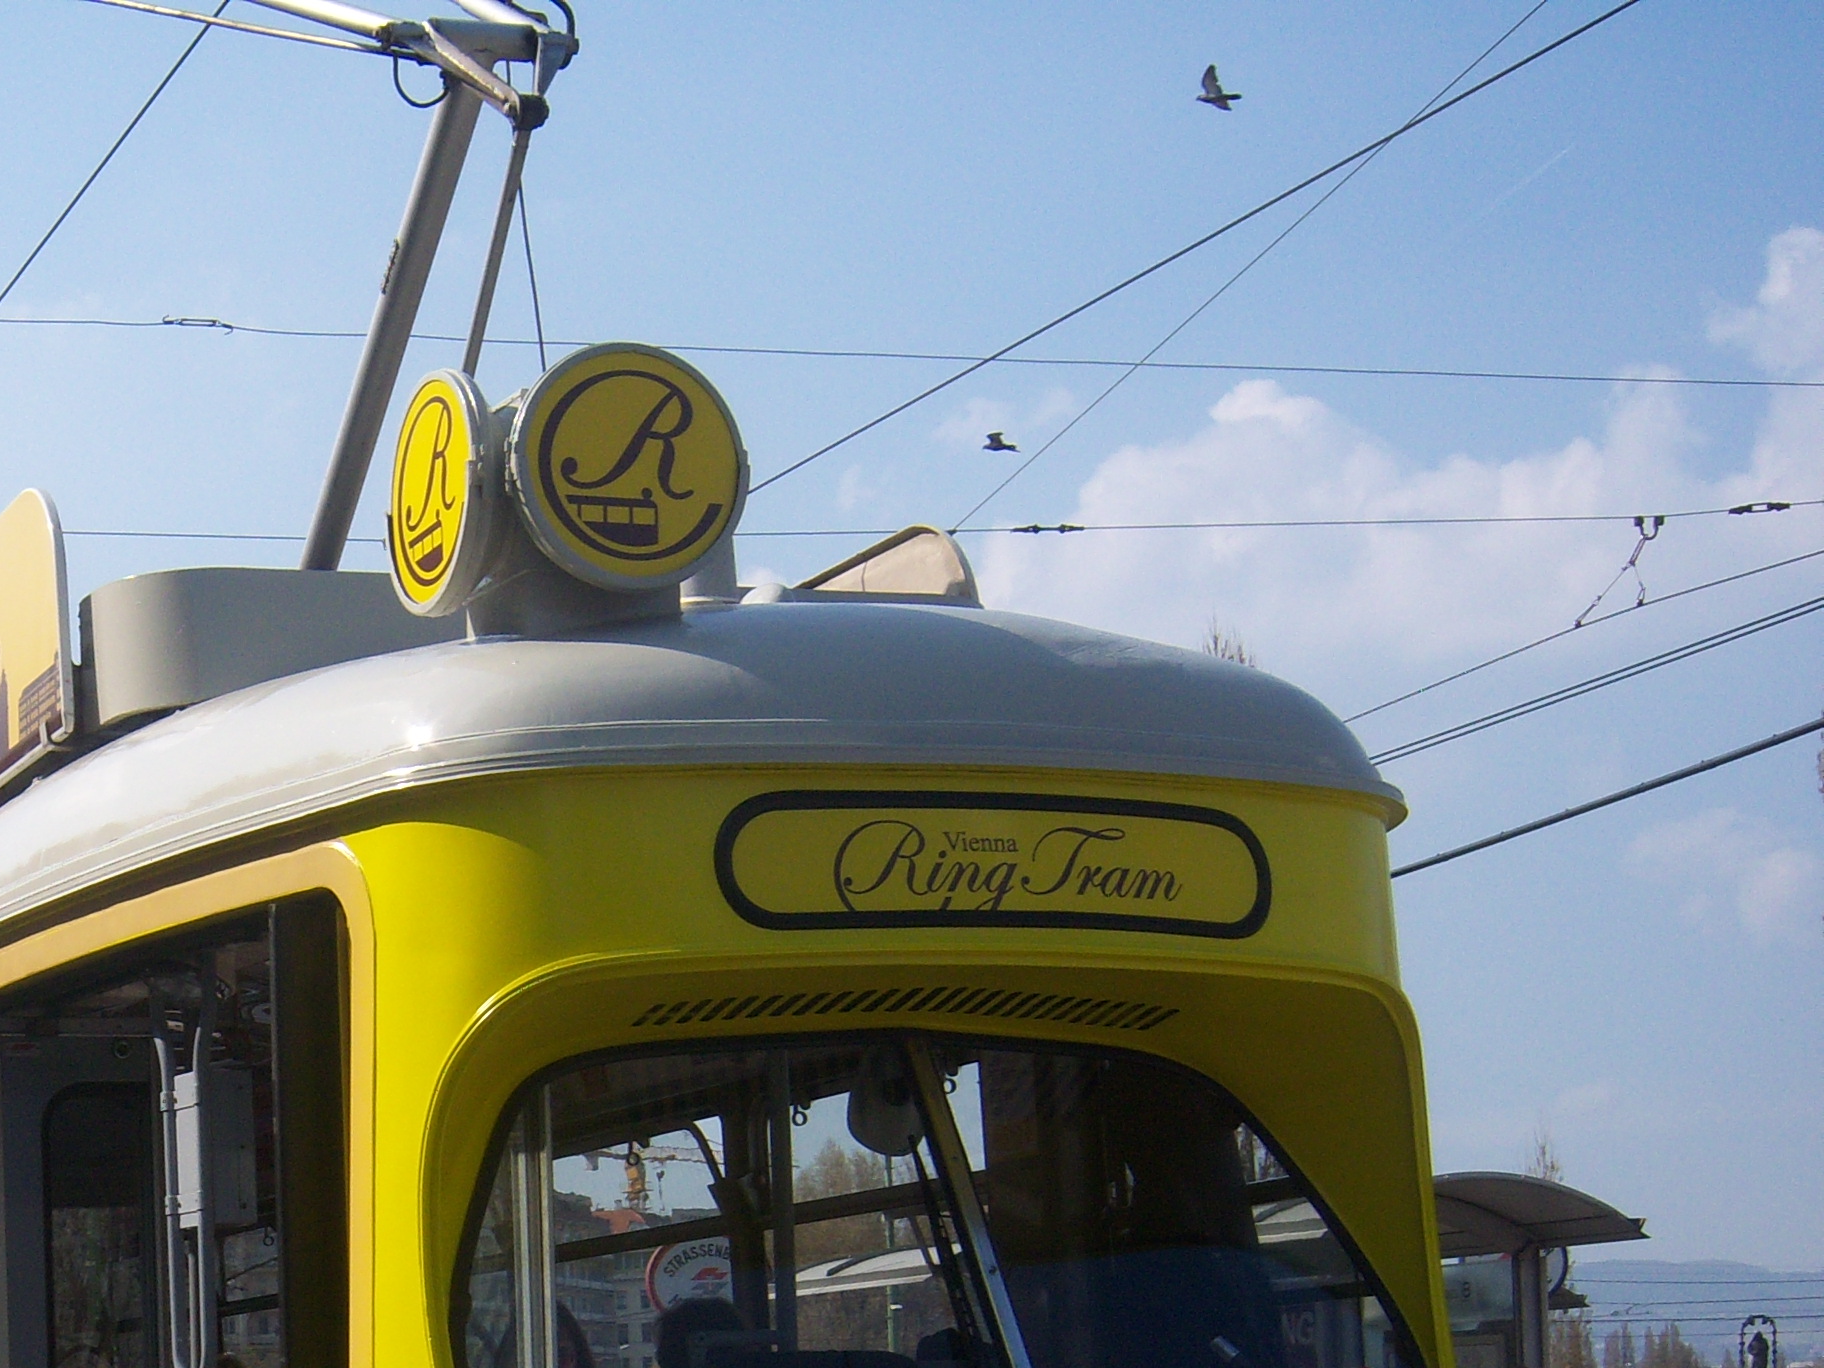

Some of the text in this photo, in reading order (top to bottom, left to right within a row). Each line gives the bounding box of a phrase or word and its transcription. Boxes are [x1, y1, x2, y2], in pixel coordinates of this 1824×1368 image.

[942, 829, 1020, 854] Vienna
[833, 819, 1185, 912] Ring Tram
[663, 1243, 730, 1277] STRASSENB
